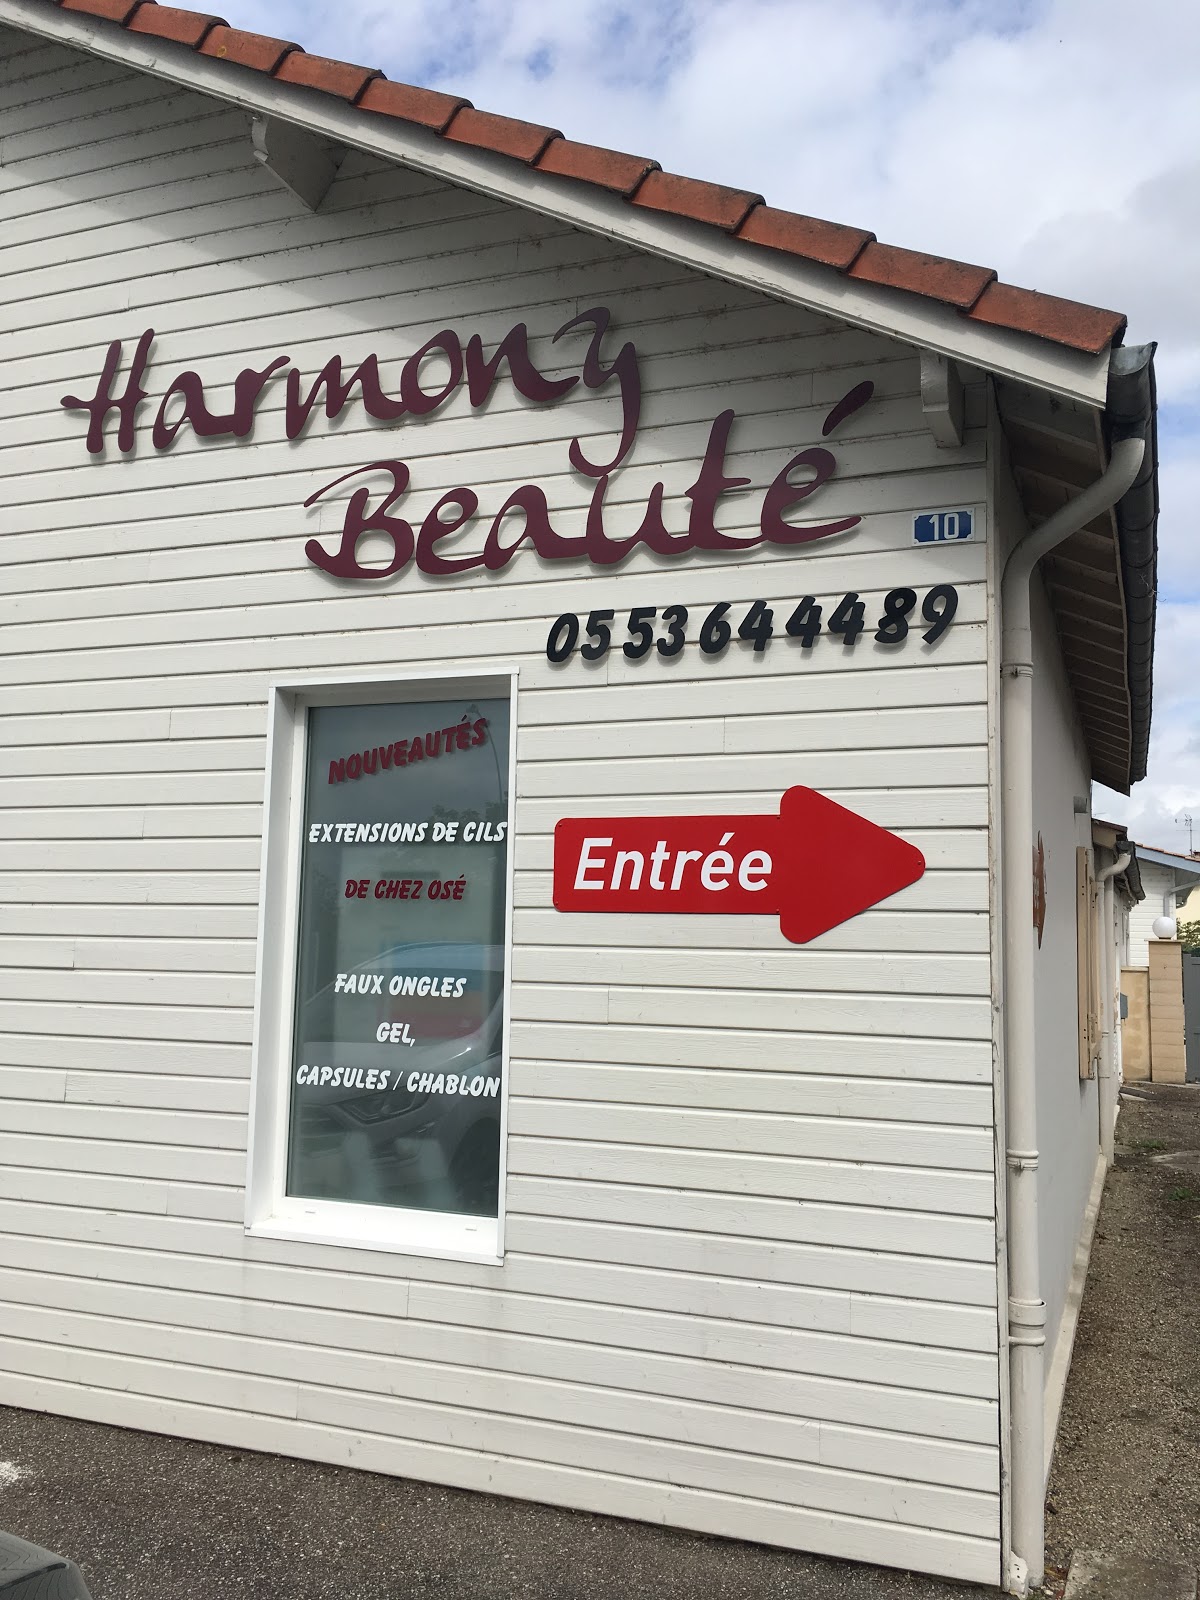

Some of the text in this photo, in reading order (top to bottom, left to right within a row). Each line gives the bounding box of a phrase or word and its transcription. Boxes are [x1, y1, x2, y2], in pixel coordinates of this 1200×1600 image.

[61, 307, 640, 477] Harmony
[304, 380, 874, 579] Beauté
[929, 513, 961, 540] 10
[328, 715, 487, 784] NOUVEAUTÉS
[308, 821, 507, 842] EXTENSIONS DE CILS
[573, 832, 773, 891] Entrée
[345, 874, 466, 900] DE CHEZ OSÉ
[334, 973, 467, 997] FAUX ONGLES
[376, 1022, 416, 1047] GEL,
[296, 1064, 390, 1090] CAPSULES
[406, 1071, 500, 1097] CHABLON
